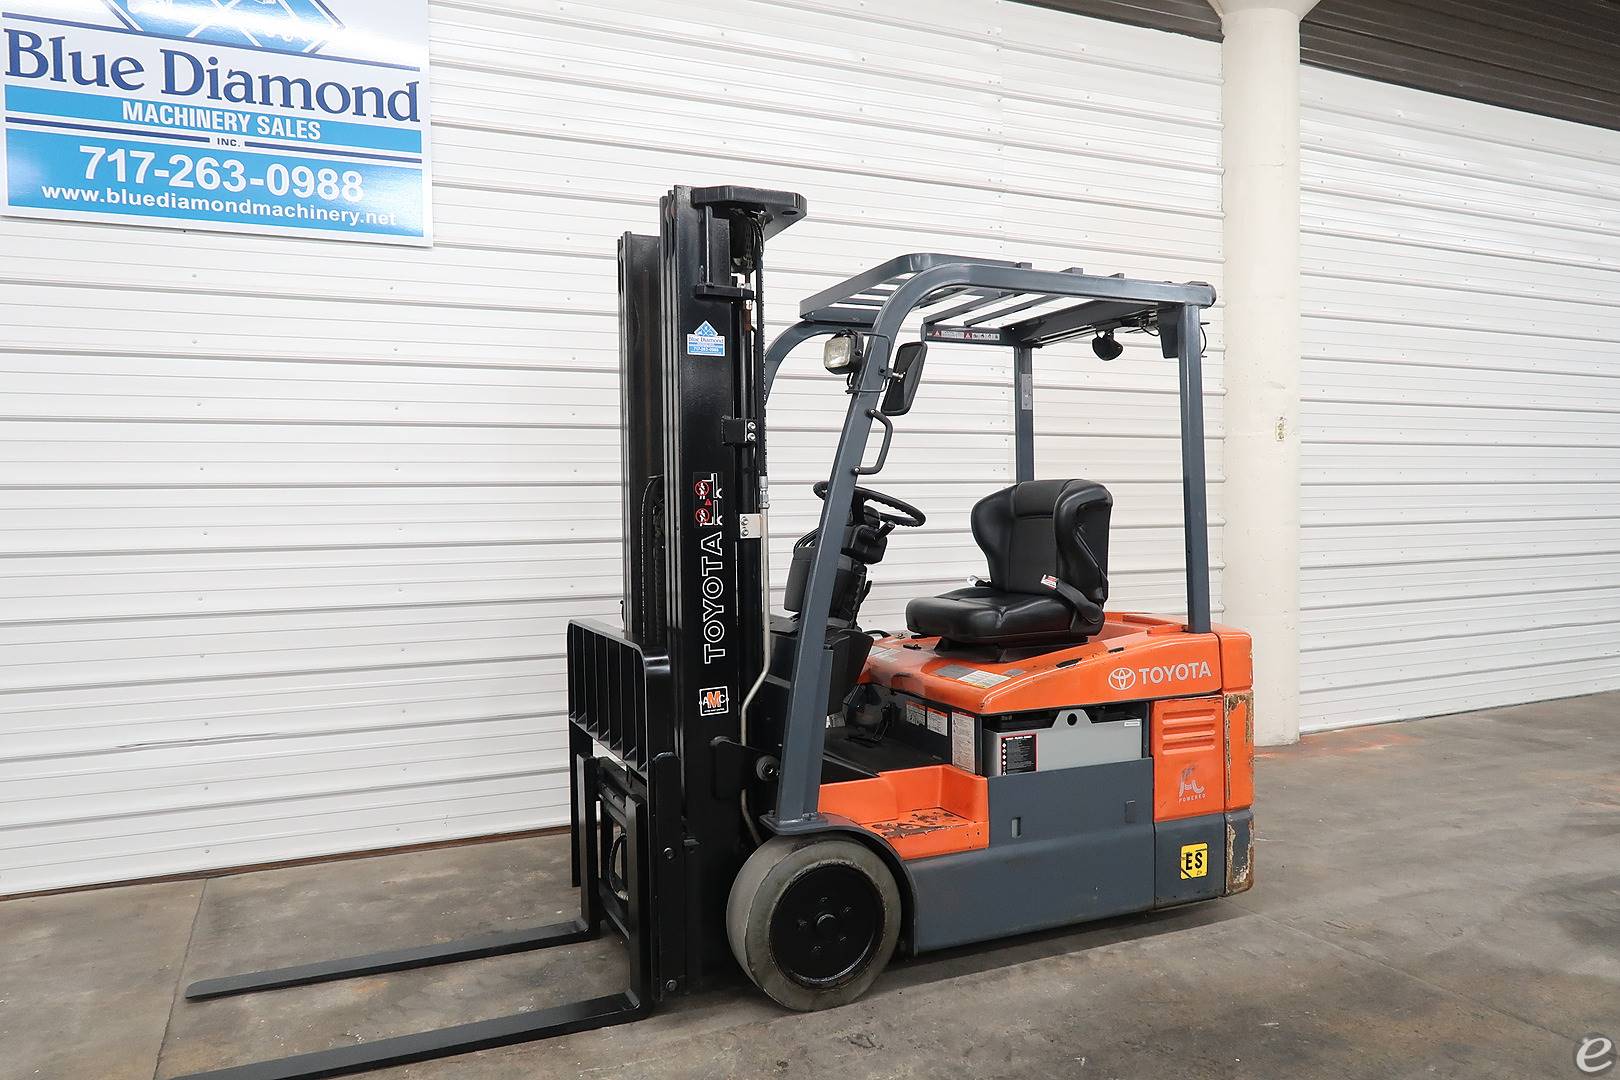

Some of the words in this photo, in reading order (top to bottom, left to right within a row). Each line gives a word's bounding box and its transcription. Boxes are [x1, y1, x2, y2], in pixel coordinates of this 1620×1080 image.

[3, 27, 145, 91] Blue
[159, 48, 421, 123] Diamond
[122, 100, 250, 134] MACHINERY
[256, 114, 321, 141] SALES
[216, 137, 241, 148] INC.
[79, 145, 364, 202] 717-263-0988
[41, 184, 398, 227] www.bluediamondmachinery.net
[701, 531, 725, 664] TOYOTA
[1138, 661, 1212, 685] TOYOTA
[702, 690, 726, 709] AMC
[1185, 851, 1203, 871] ES
